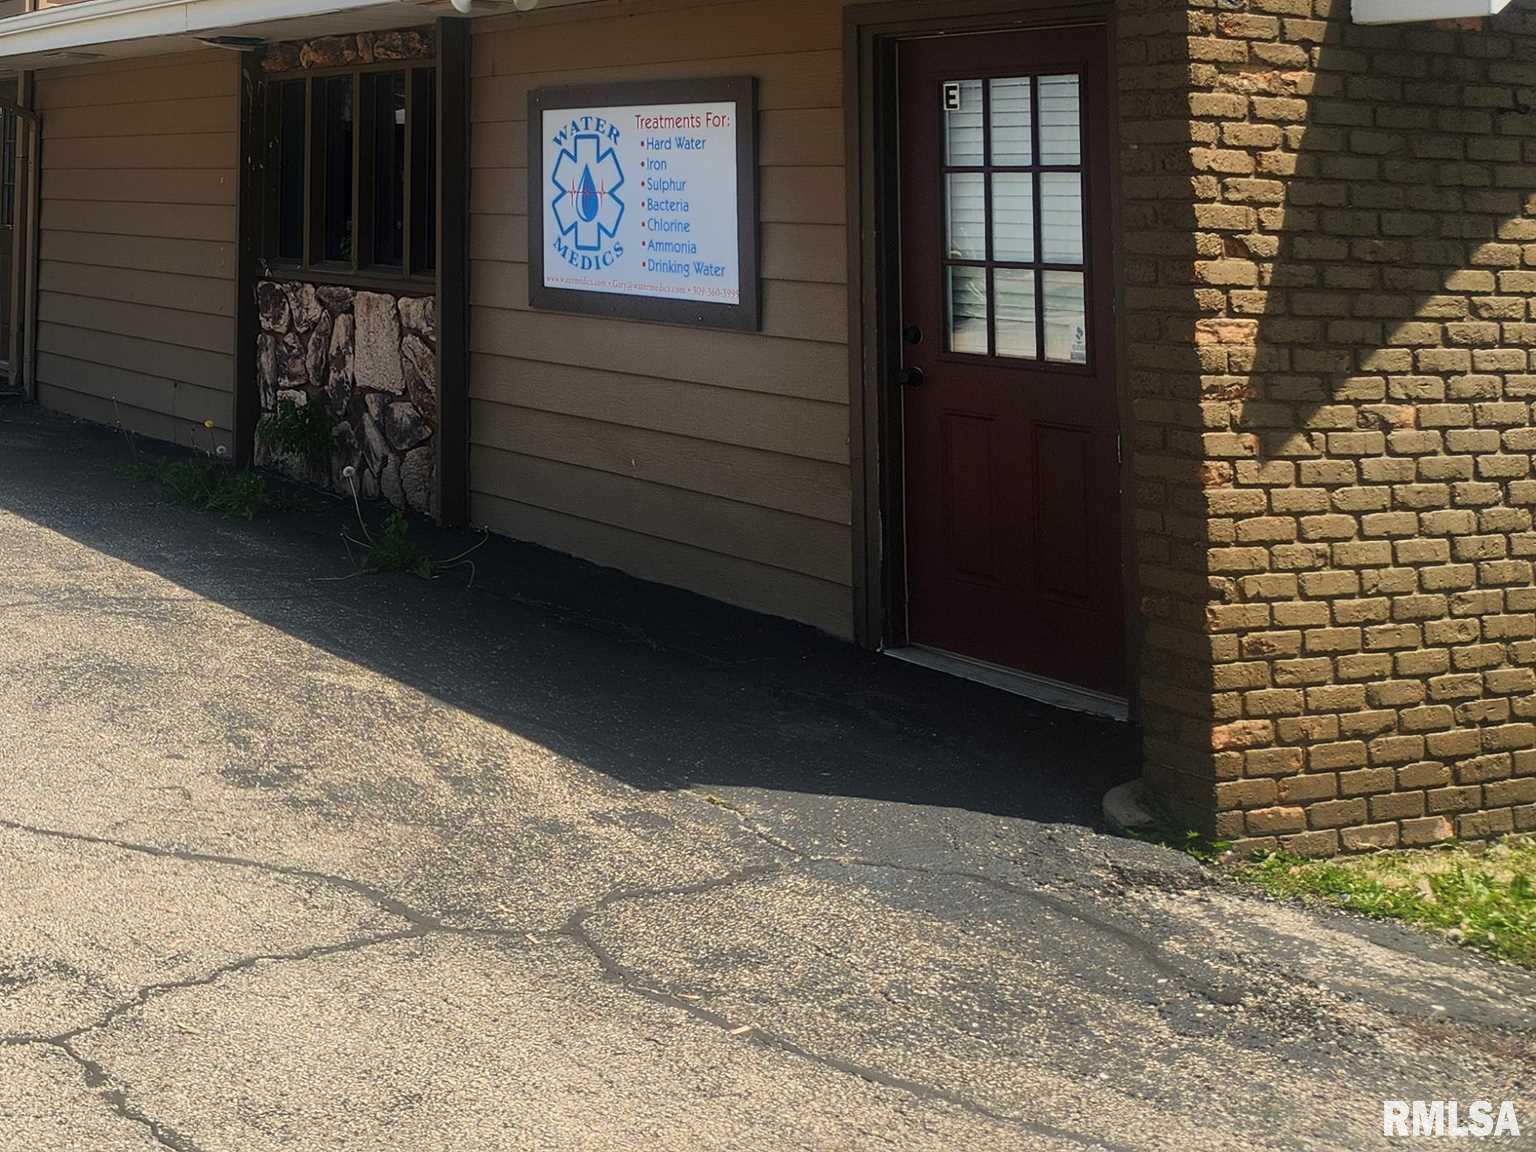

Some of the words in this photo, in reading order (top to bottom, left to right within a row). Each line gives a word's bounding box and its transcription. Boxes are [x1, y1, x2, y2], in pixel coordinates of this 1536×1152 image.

[945, 85, 958, 109] E
[635, 113, 701, 130] Treatments
[705, 112, 731, 128] For:
[552, 116, 620, 147] WATER
[646, 137, 672, 151] Hard
[675, 137, 706, 150] Water
[646, 157, 667, 170] Iron
[647, 178, 686, 194] Sulphur
[647, 199, 689, 213] Bacteria
[647, 218, 690, 233] Chlorine
[553, 237, 624, 270] MEDICS
[648, 239, 697, 255] Ammonia
[648, 260, 690, 278] Drinking
[693, 261, 726, 277] Water
